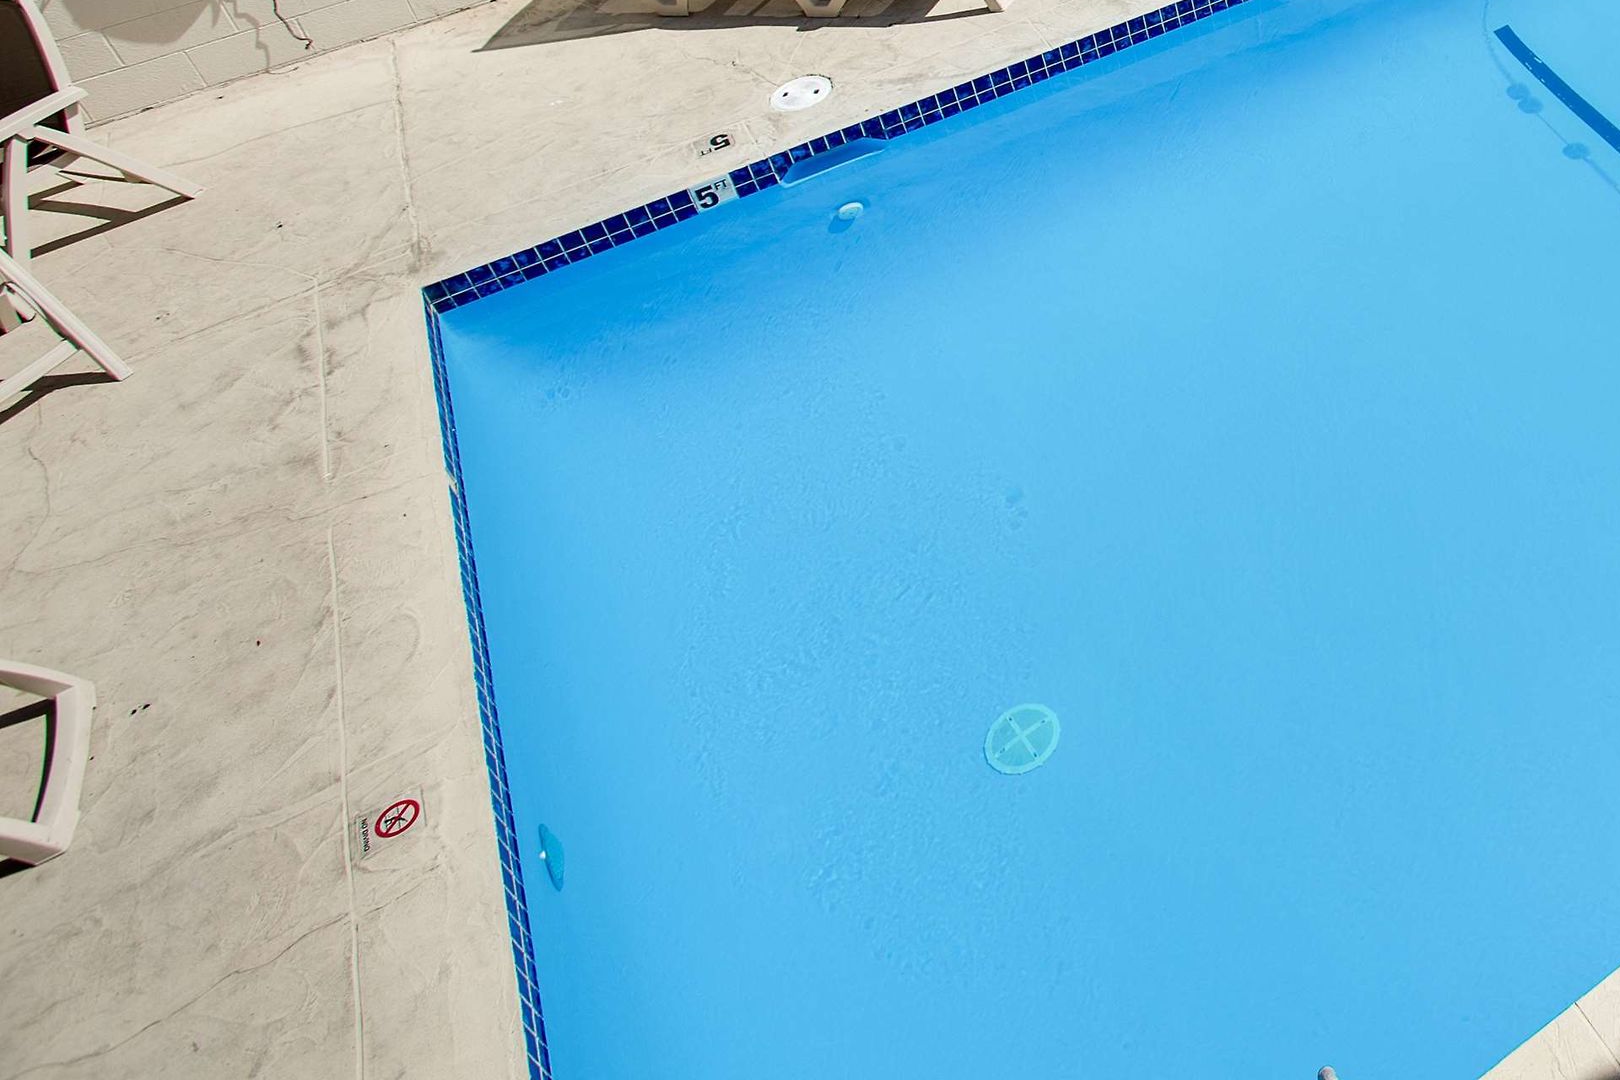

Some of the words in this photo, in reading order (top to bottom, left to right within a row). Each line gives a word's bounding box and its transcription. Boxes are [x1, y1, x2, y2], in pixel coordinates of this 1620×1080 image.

[710, 134, 731, 150] 5
[695, 185, 721, 209] 5
[714, 179, 728, 191] FT
[361, 817, 368, 829] NO
